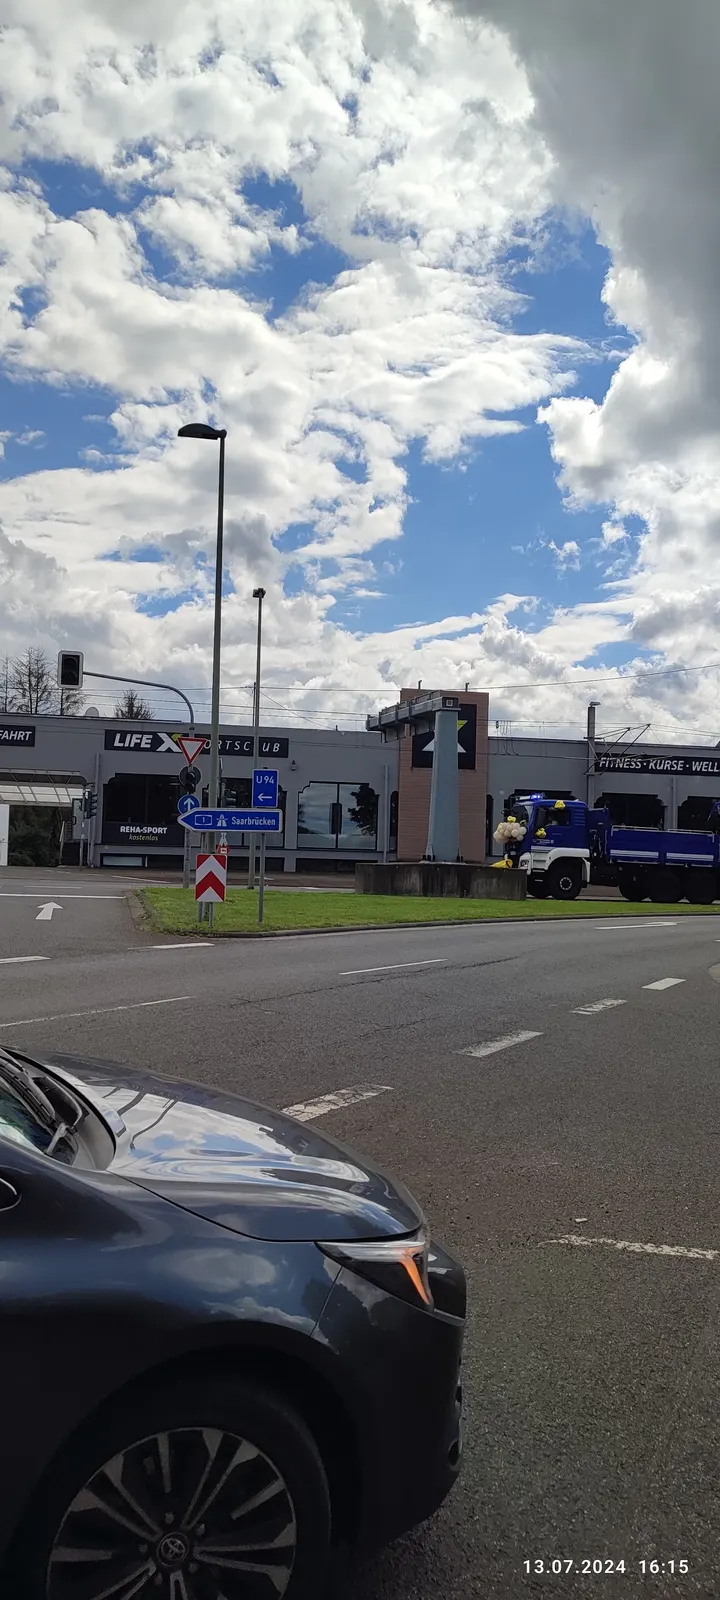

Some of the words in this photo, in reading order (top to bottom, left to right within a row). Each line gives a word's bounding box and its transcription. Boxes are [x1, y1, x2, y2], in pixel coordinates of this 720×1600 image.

[113, 733, 153, 748] LIFE
[599, 757, 642, 769] FITNESS
[648, 759, 685, 771] KURSE
[692, 761, 720, 772] WELL
[232, 816, 275, 826] Saarbrücken
[120, 825, 168, 834] REHA-SPORT
